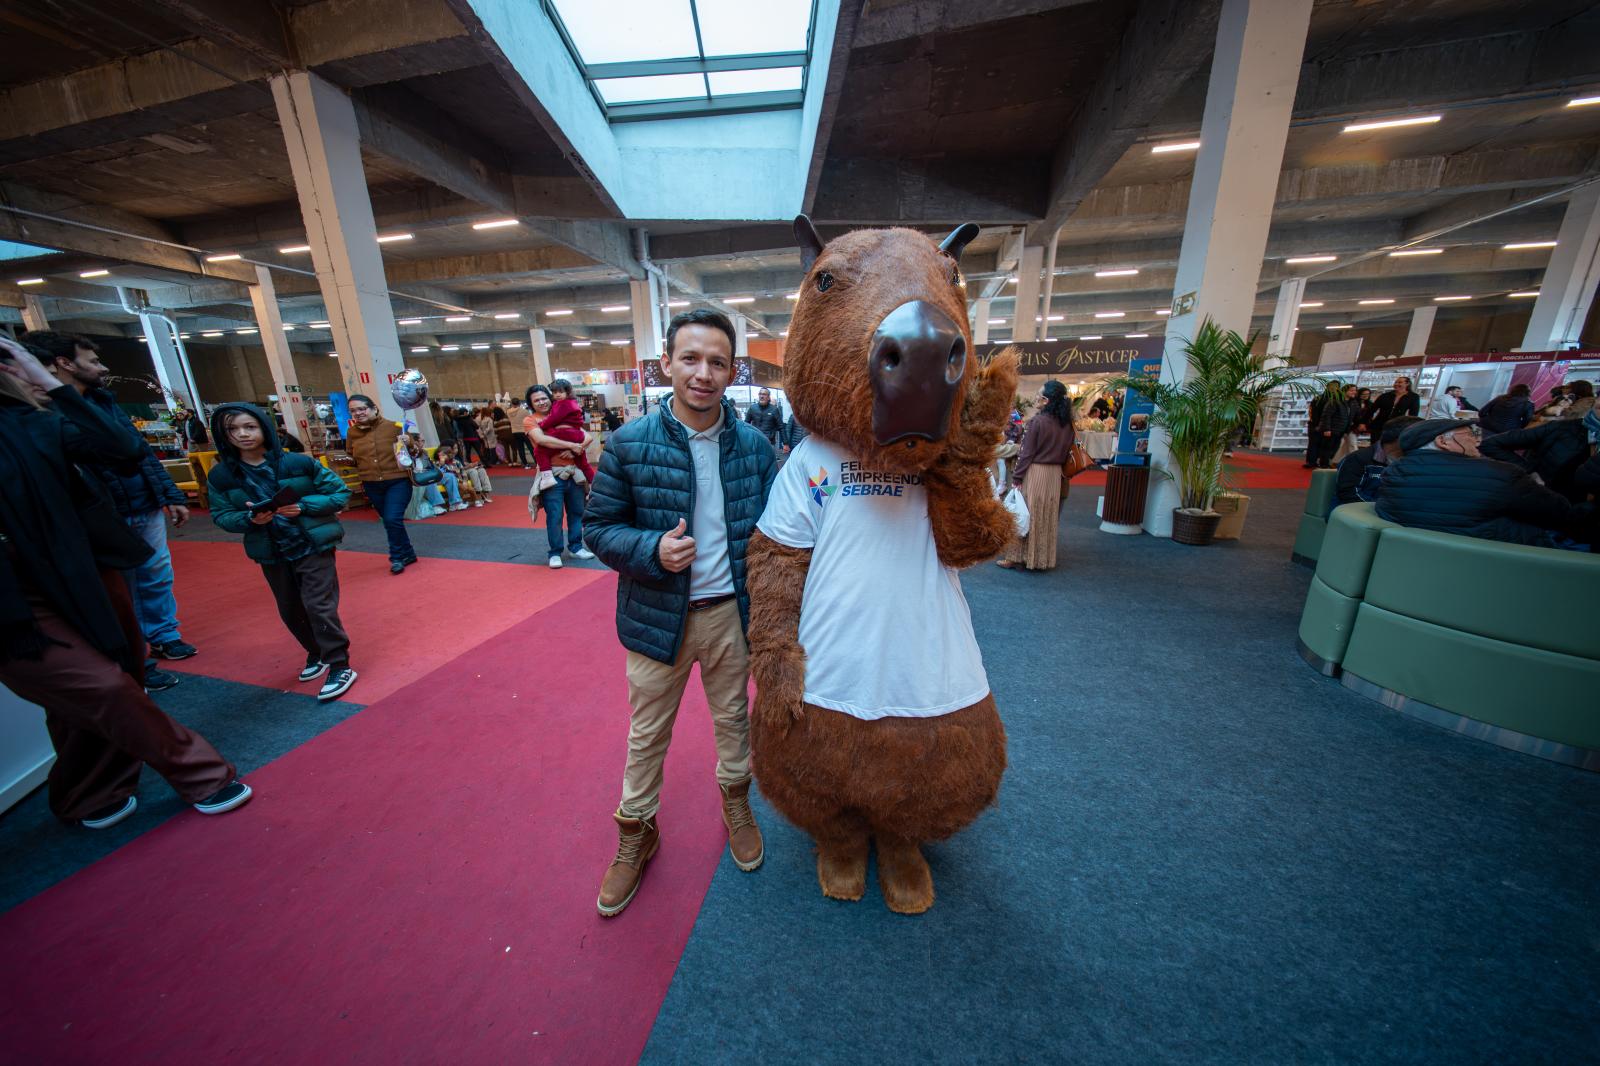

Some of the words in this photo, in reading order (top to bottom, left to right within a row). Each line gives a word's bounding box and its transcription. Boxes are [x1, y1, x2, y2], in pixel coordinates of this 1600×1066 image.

[1056, 345, 1139, 372] PASTACER
[1143, 364, 1161, 373] QUE
[841, 472, 923, 485] EMPREEND
[841, 484, 903, 497] SEBRAE
